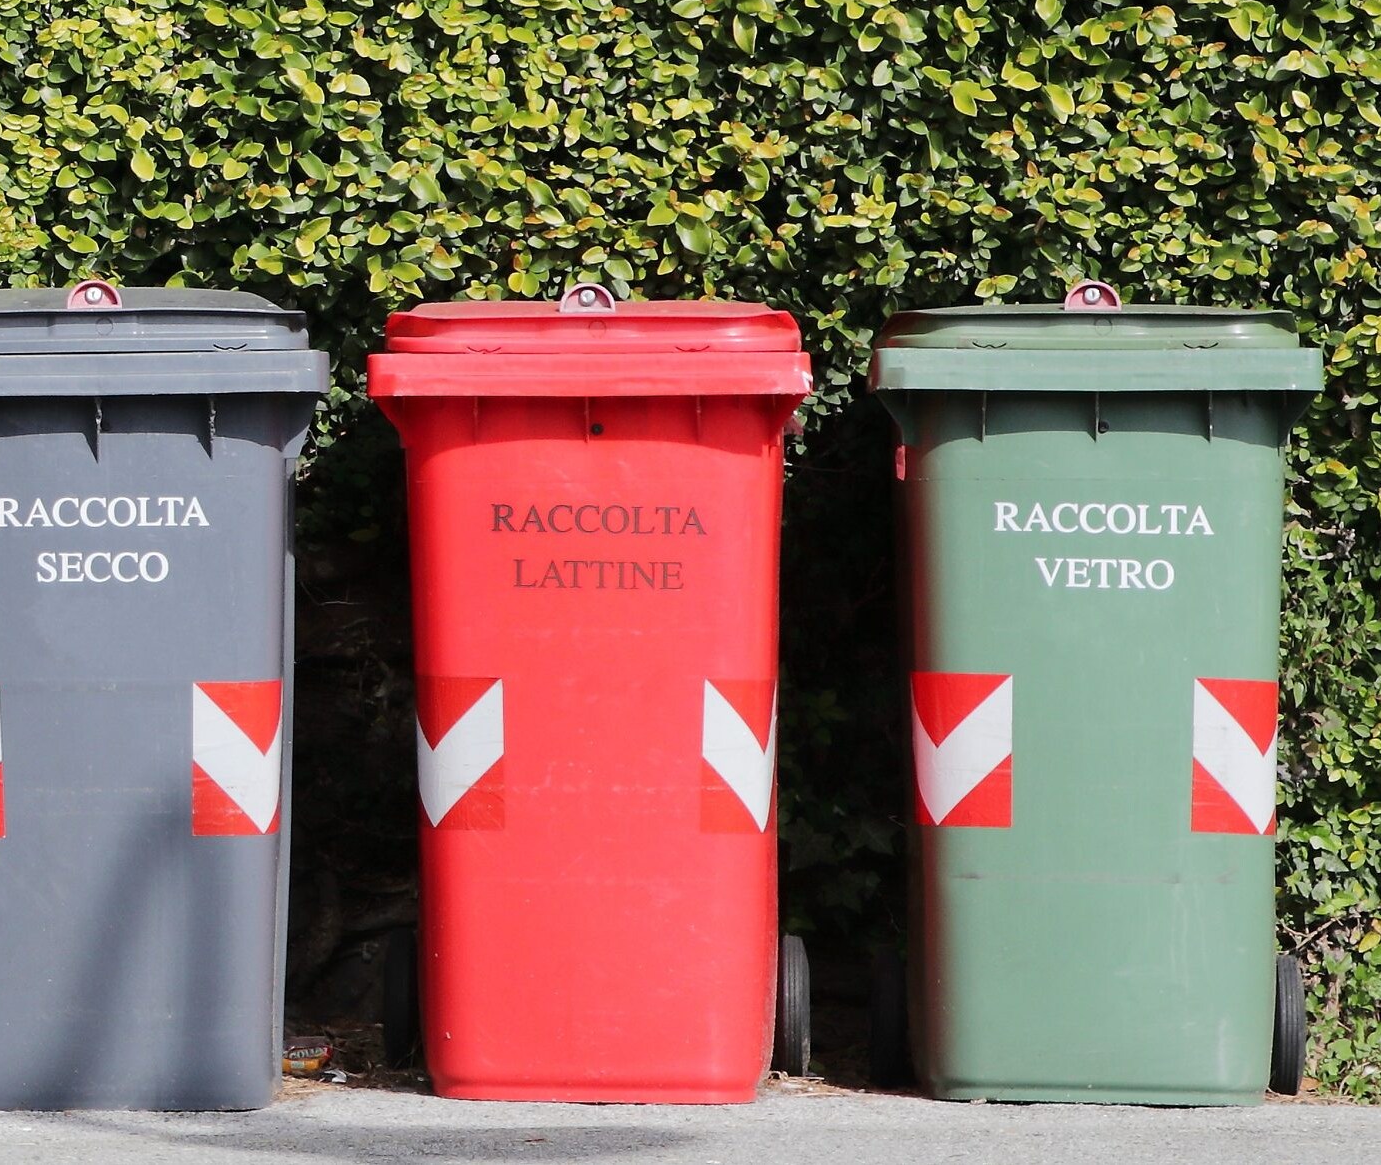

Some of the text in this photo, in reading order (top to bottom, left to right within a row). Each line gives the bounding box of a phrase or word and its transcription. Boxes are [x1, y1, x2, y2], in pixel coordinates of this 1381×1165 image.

[491, 503, 707, 535] RACCOLTA
[994, 501, 1214, 536] RACCOLTA
[36, 551, 169, 583] SECCO
[513, 558, 684, 590] LATTINE
[1035, 557, 1175, 590] VETRO
